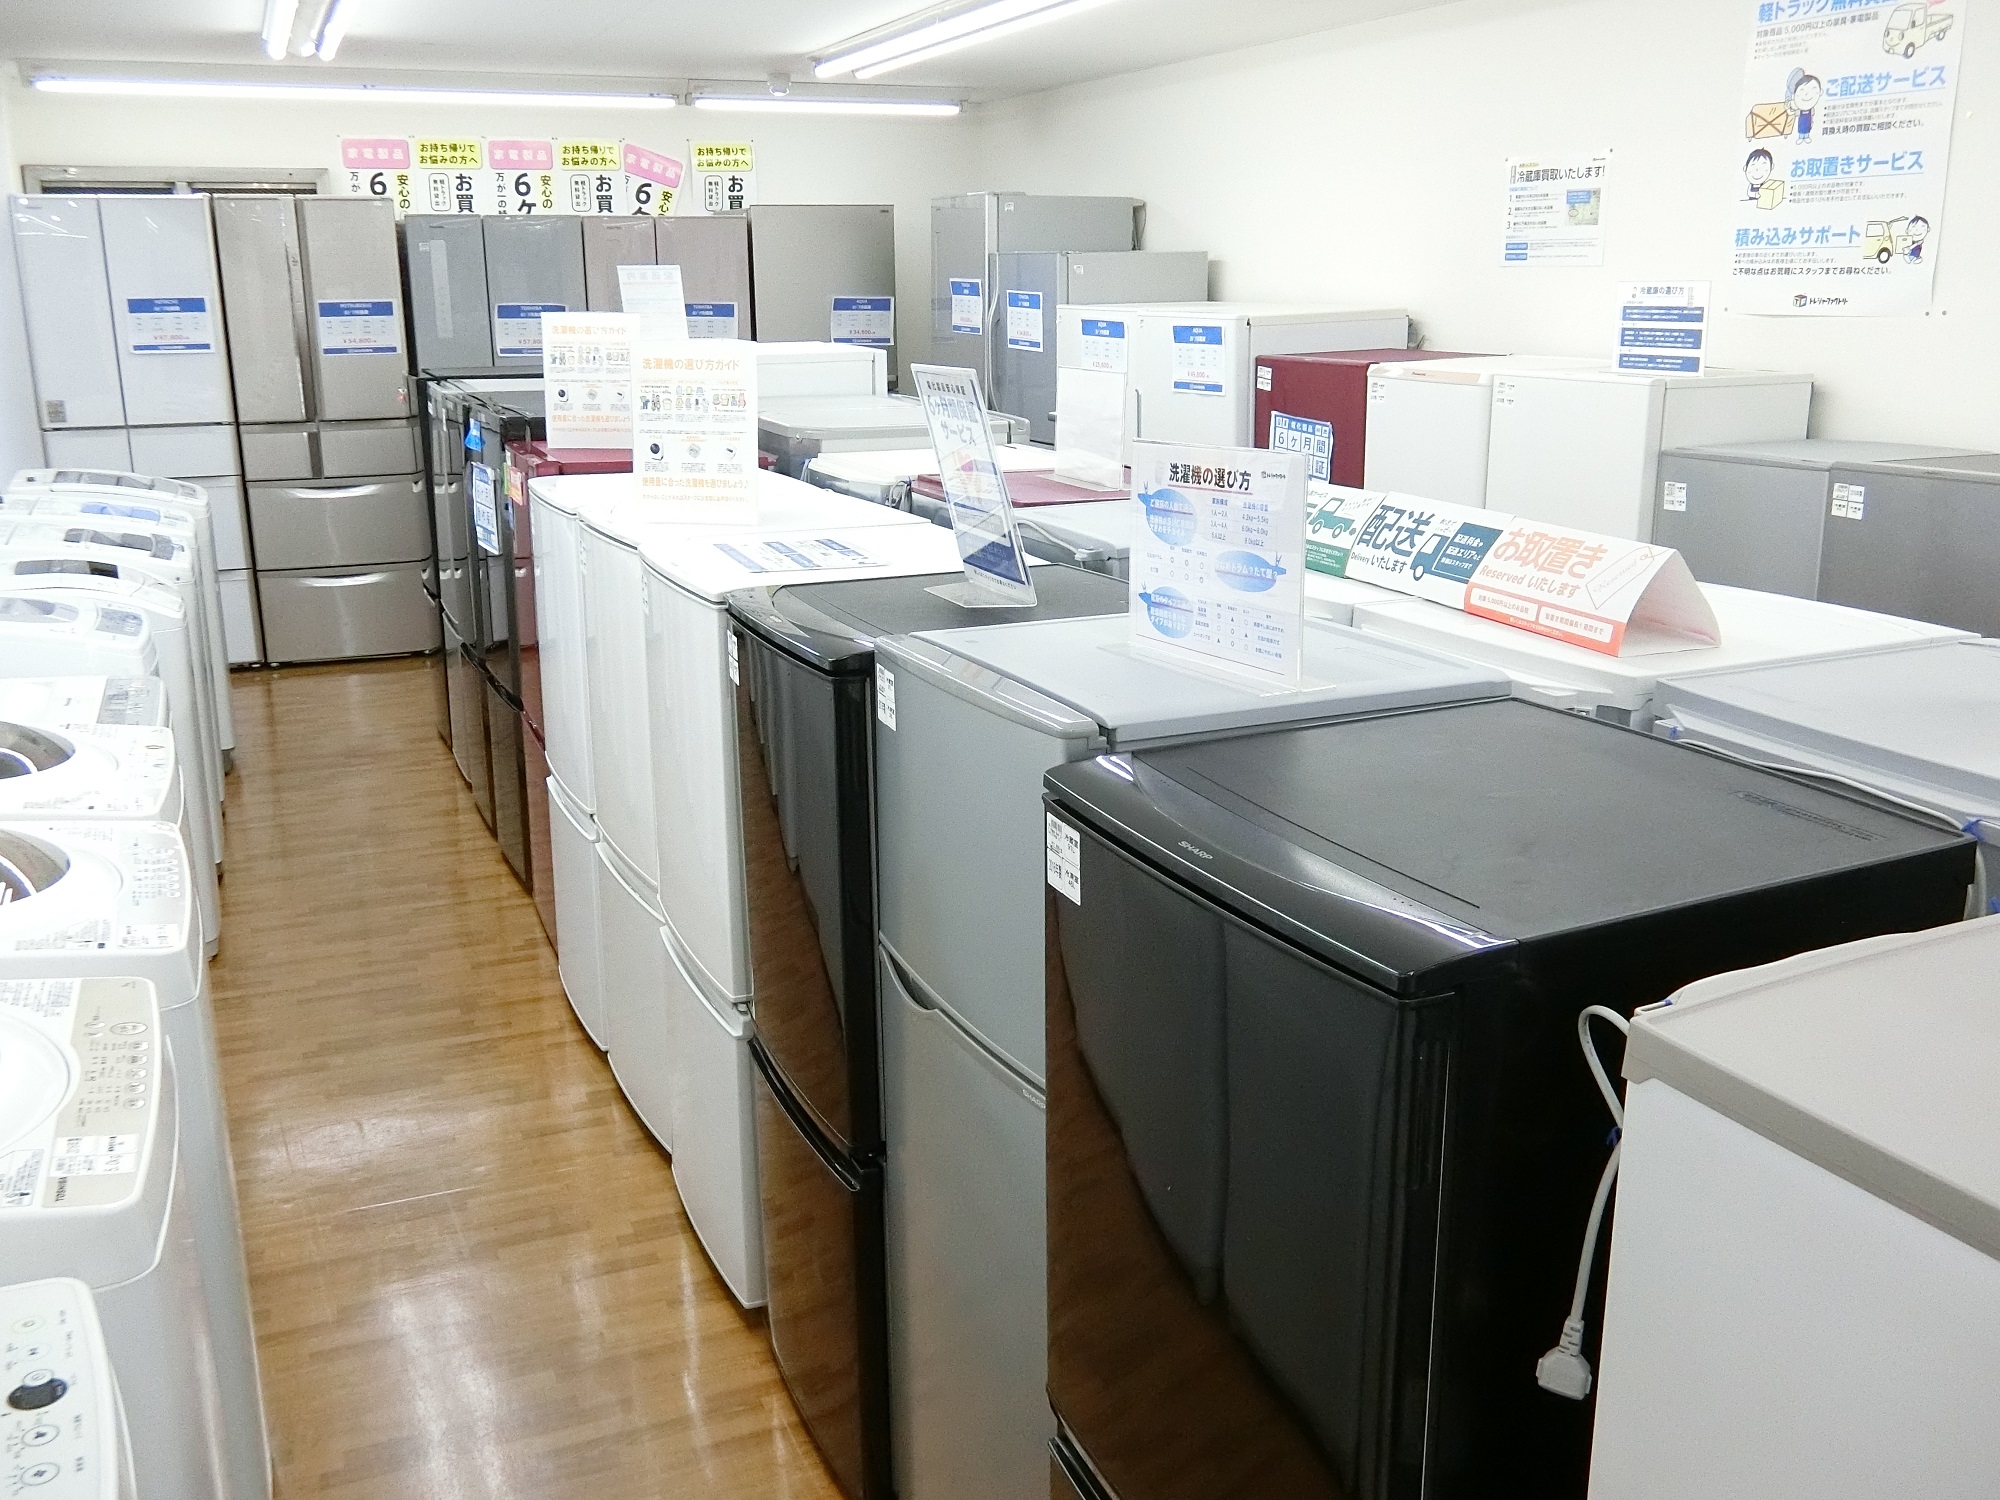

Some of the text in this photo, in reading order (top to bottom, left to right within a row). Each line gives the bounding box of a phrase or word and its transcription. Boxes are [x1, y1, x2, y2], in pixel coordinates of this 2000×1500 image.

[1825, 65, 1946, 98] ご配送サービス
[419, 155, 479, 165] お悩みの方へ
[561, 157, 618, 166] お悩みの方へ
[697, 159, 749, 168] お悩みの方へ
[1790, 150, 1924, 178] お取置きサービス
[1516, 165, 1606, 183] 冷蔵庫買取いたします!
[1735, 225, 1861, 247] 積み込みサポート
[642, 357, 740, 371] 洗濯機の選び方ガイド
[940, 420, 977, 447] サービス
[1168, 462, 1252, 491] 洗濯機の選び方
[1357, 504, 1436, 557] 配送
[1371, 554, 1408, 574] いたします
[1493, 527, 1609, 580] お取置き
[1479, 564, 1527, 584] Reserved
[1528, 575, 1581, 599] いたします
[1178, 840, 1213, 861] SHARP
